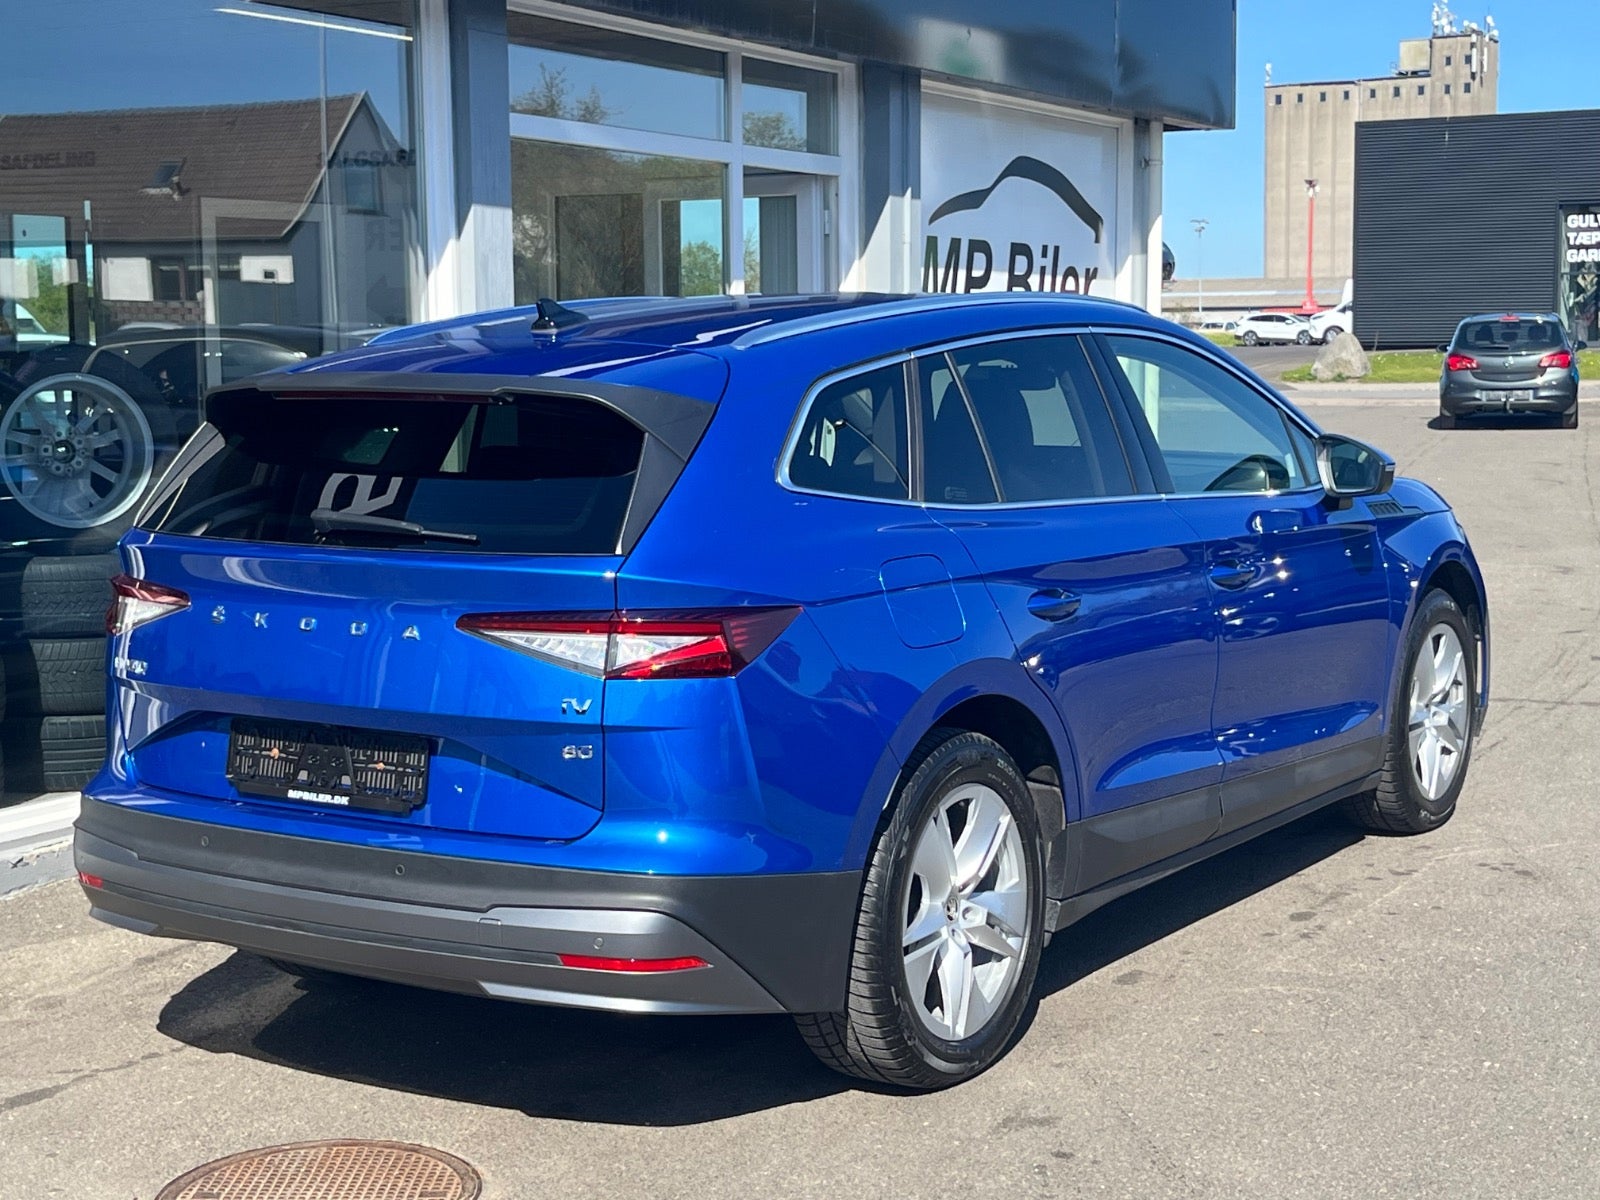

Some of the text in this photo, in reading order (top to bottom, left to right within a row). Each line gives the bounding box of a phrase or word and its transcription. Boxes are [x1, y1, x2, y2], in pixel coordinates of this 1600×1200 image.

[1567, 214, 1600, 228] GUL
[1566, 248, 1600, 262] GAR
[922, 235, 993, 294] MP
